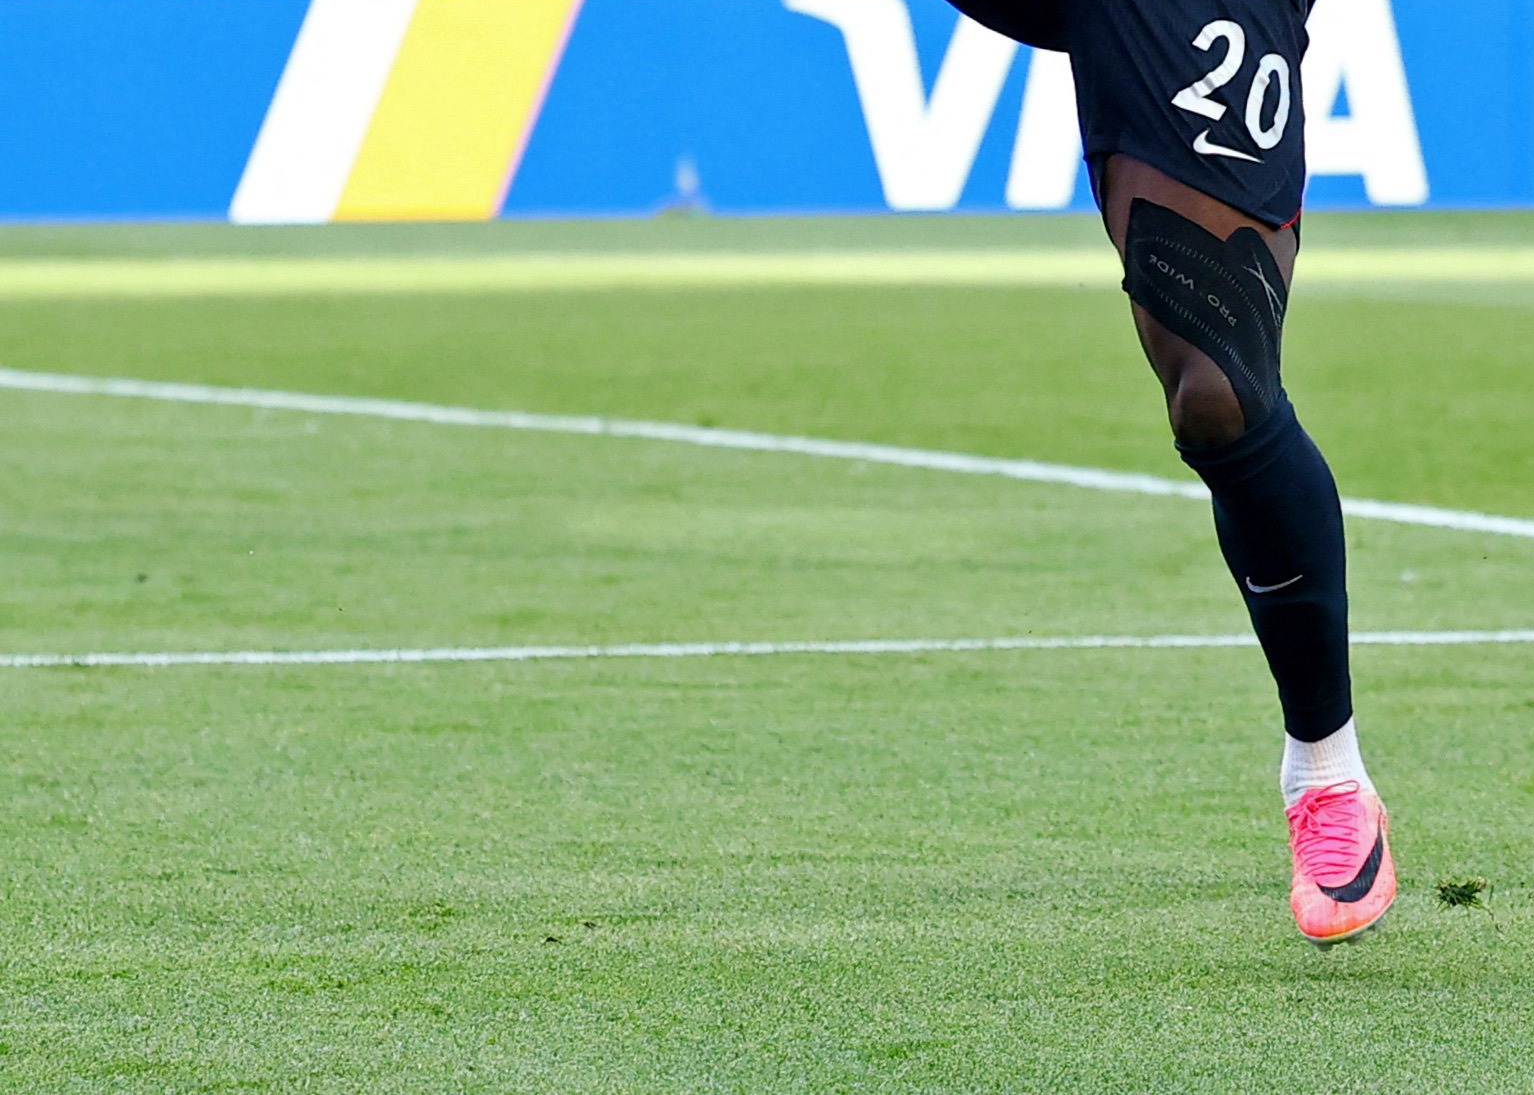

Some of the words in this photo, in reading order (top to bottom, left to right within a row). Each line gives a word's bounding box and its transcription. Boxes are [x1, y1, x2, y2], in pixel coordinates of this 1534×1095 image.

[1171, 19, 1290, 150] 20
[1149, 254, 1195, 290] WIDE
[1207, 294, 1238, 328] PRO
